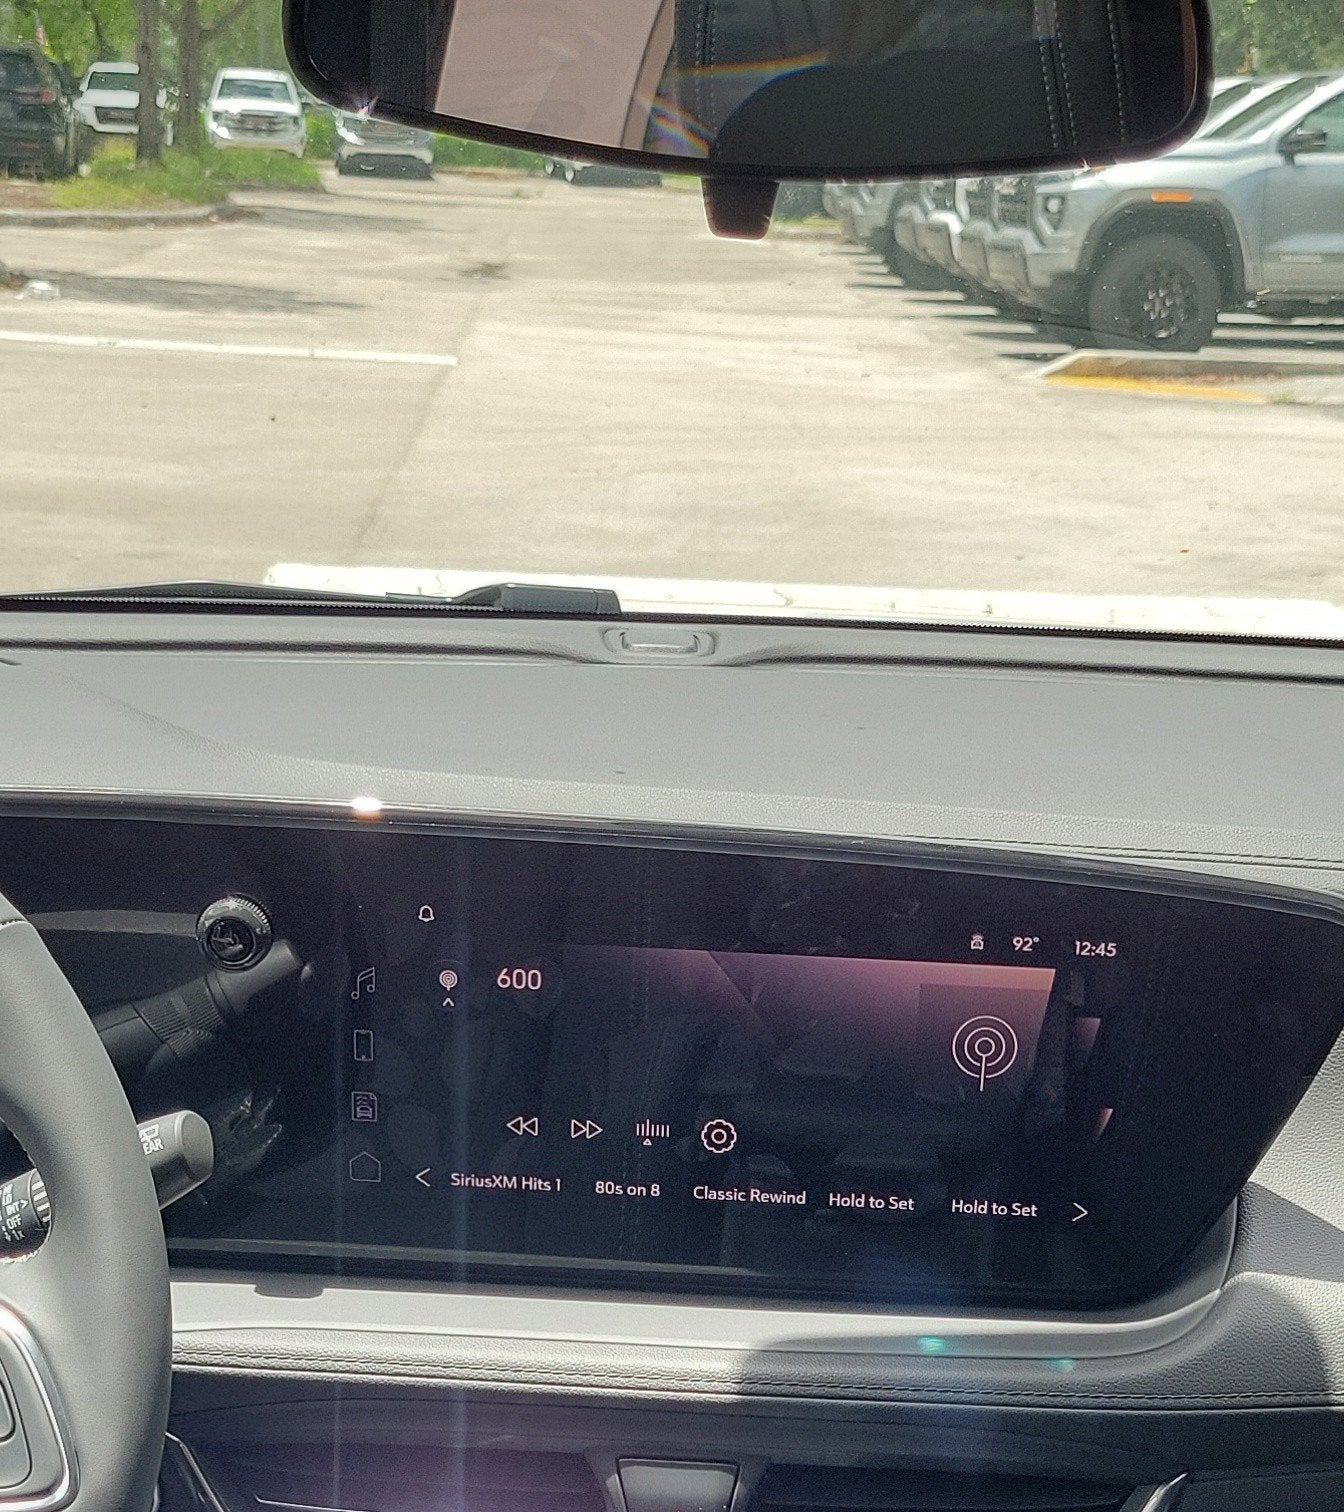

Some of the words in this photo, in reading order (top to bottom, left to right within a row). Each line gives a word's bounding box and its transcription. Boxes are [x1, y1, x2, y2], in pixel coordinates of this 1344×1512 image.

[1012, 936, 1040, 951] 92°
[1074, 940, 1117, 957] 12:45
[497, 968, 542, 990] 600
[142, 1138, 164, 1156] EAR
[451, 1172, 518, 1189] SiriusXM
[522, 1175, 552, 1191] Hits
[555, 1178, 561, 1191] 1
[595, 1181, 624, 1196] 80s
[627, 1184, 646, 1197] on
[650, 1184, 661, 1197] 8
[693, 1186, 747, 1202] Classic
[750, 1189, 807, 1205] Rewind
[829, 1192, 865, 1209] Hold
[869, 1195, 885, 1209] to
[889, 1196, 915, 1211] Set
[951, 1199, 988, 1215] Hold
[992, 1201, 1008, 1216] to
[1011, 1203, 1038, 1218] Set
[6, 1214, 22, 1230] OFF
